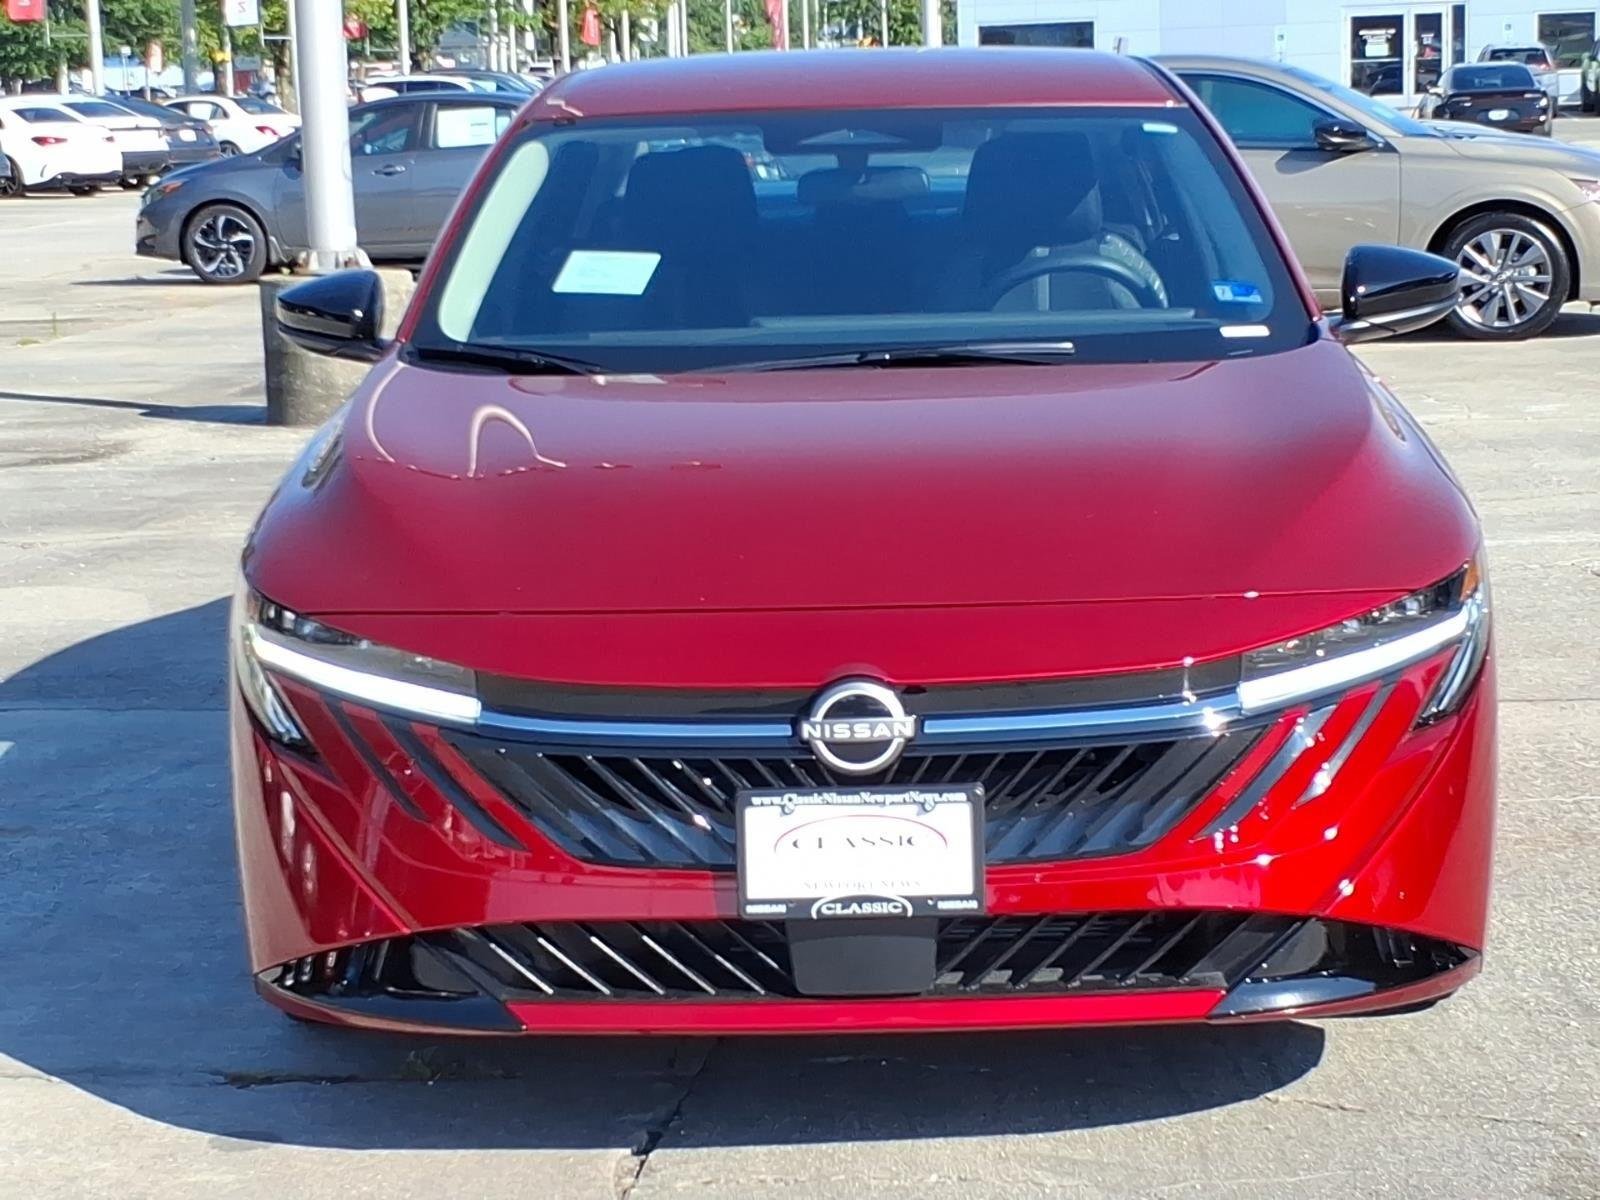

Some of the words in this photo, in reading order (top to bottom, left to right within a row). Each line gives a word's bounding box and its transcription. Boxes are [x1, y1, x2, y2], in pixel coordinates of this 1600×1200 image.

[802, 721, 914, 739] NISSAN
[791, 835, 915, 849] CLASSIC
[821, 902, 903, 914] CLASSIC
